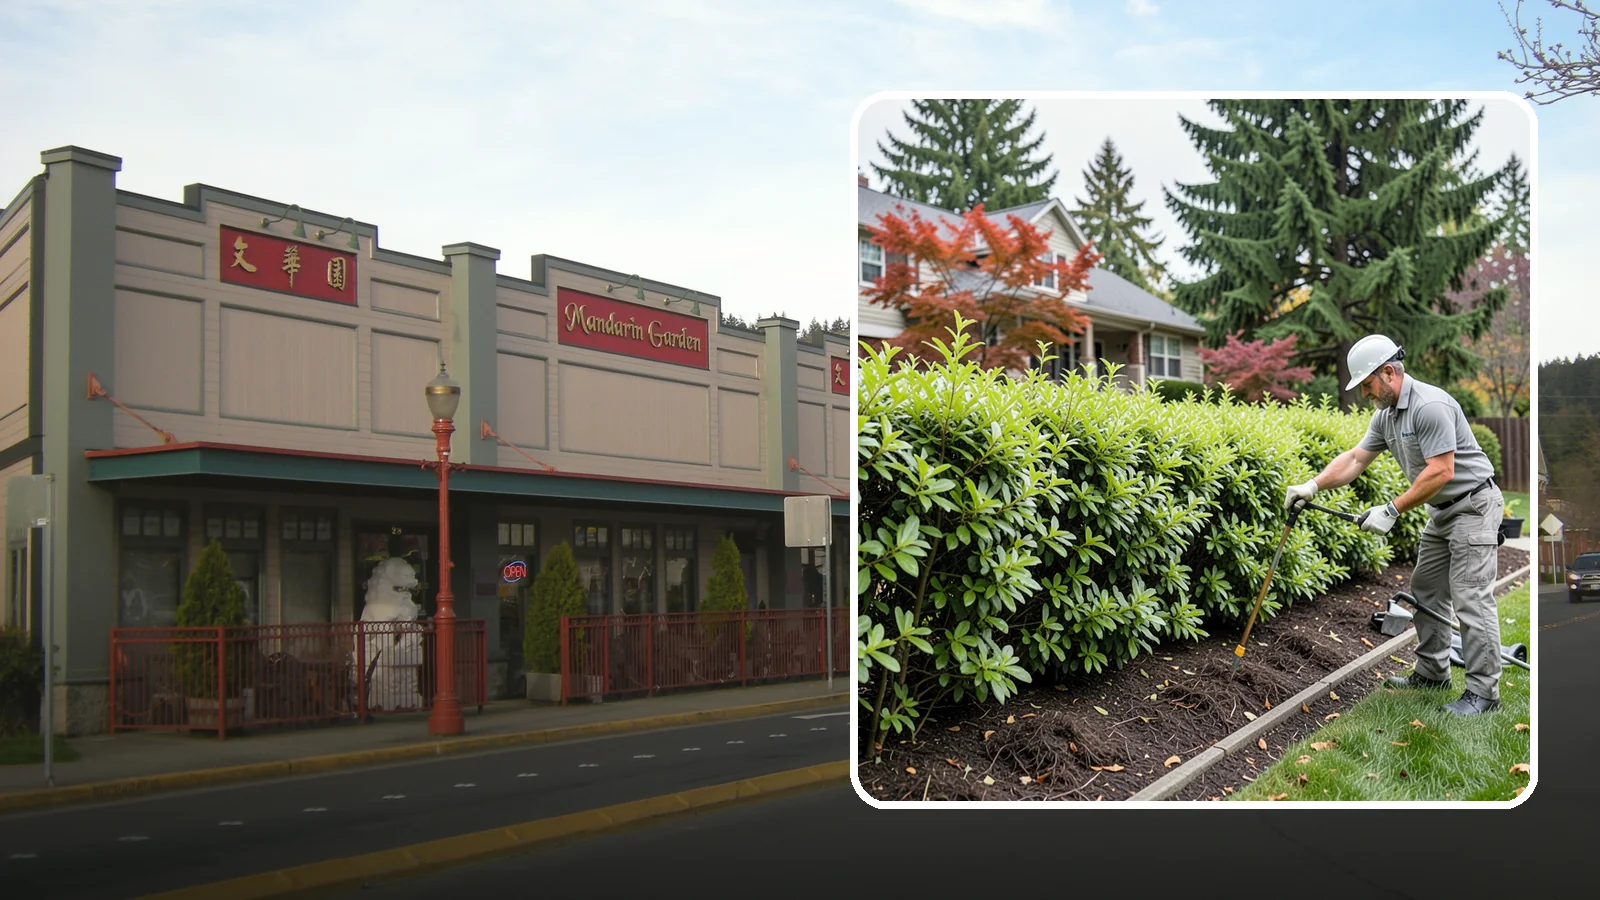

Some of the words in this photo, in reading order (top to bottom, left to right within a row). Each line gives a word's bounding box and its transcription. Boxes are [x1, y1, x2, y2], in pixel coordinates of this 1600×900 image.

[231, 236, 346, 291] 文華園
[564, 302, 644, 341] Mandarin
[648, 320, 702, 352] Garden
[504, 565, 527, 578] OPEN
